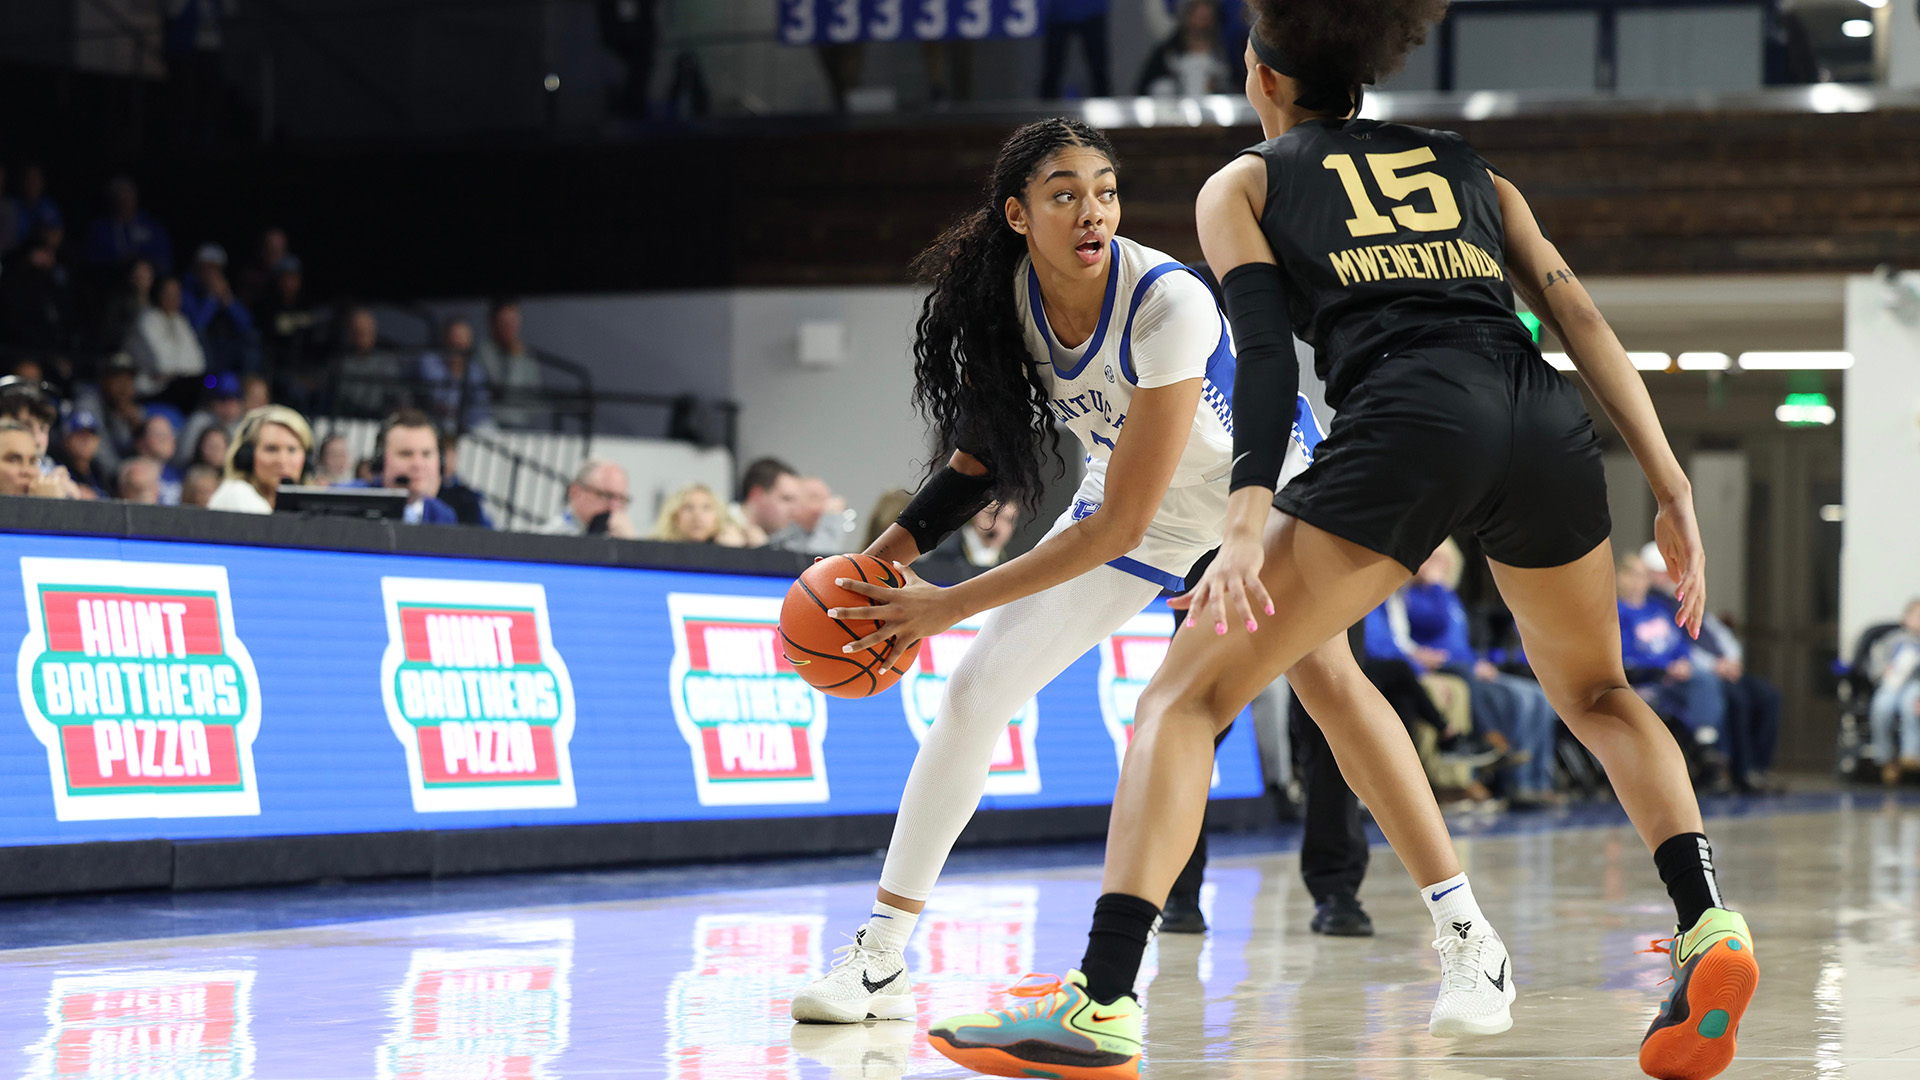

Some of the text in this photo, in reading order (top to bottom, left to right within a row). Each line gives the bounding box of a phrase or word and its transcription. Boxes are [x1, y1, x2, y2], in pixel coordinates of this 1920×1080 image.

[1322, 146, 1462, 237] 15
[1328, 239, 1504, 287] MWENENTANDA
[77, 599, 187, 659] HUNT
[425, 614, 514, 669] HUNT
[41, 661, 241, 716] BROTHERS
[400, 669, 560, 719] BROTHERS
[92, 719, 211, 777] PIZZA
[439, 720, 537, 774] PIZZA
